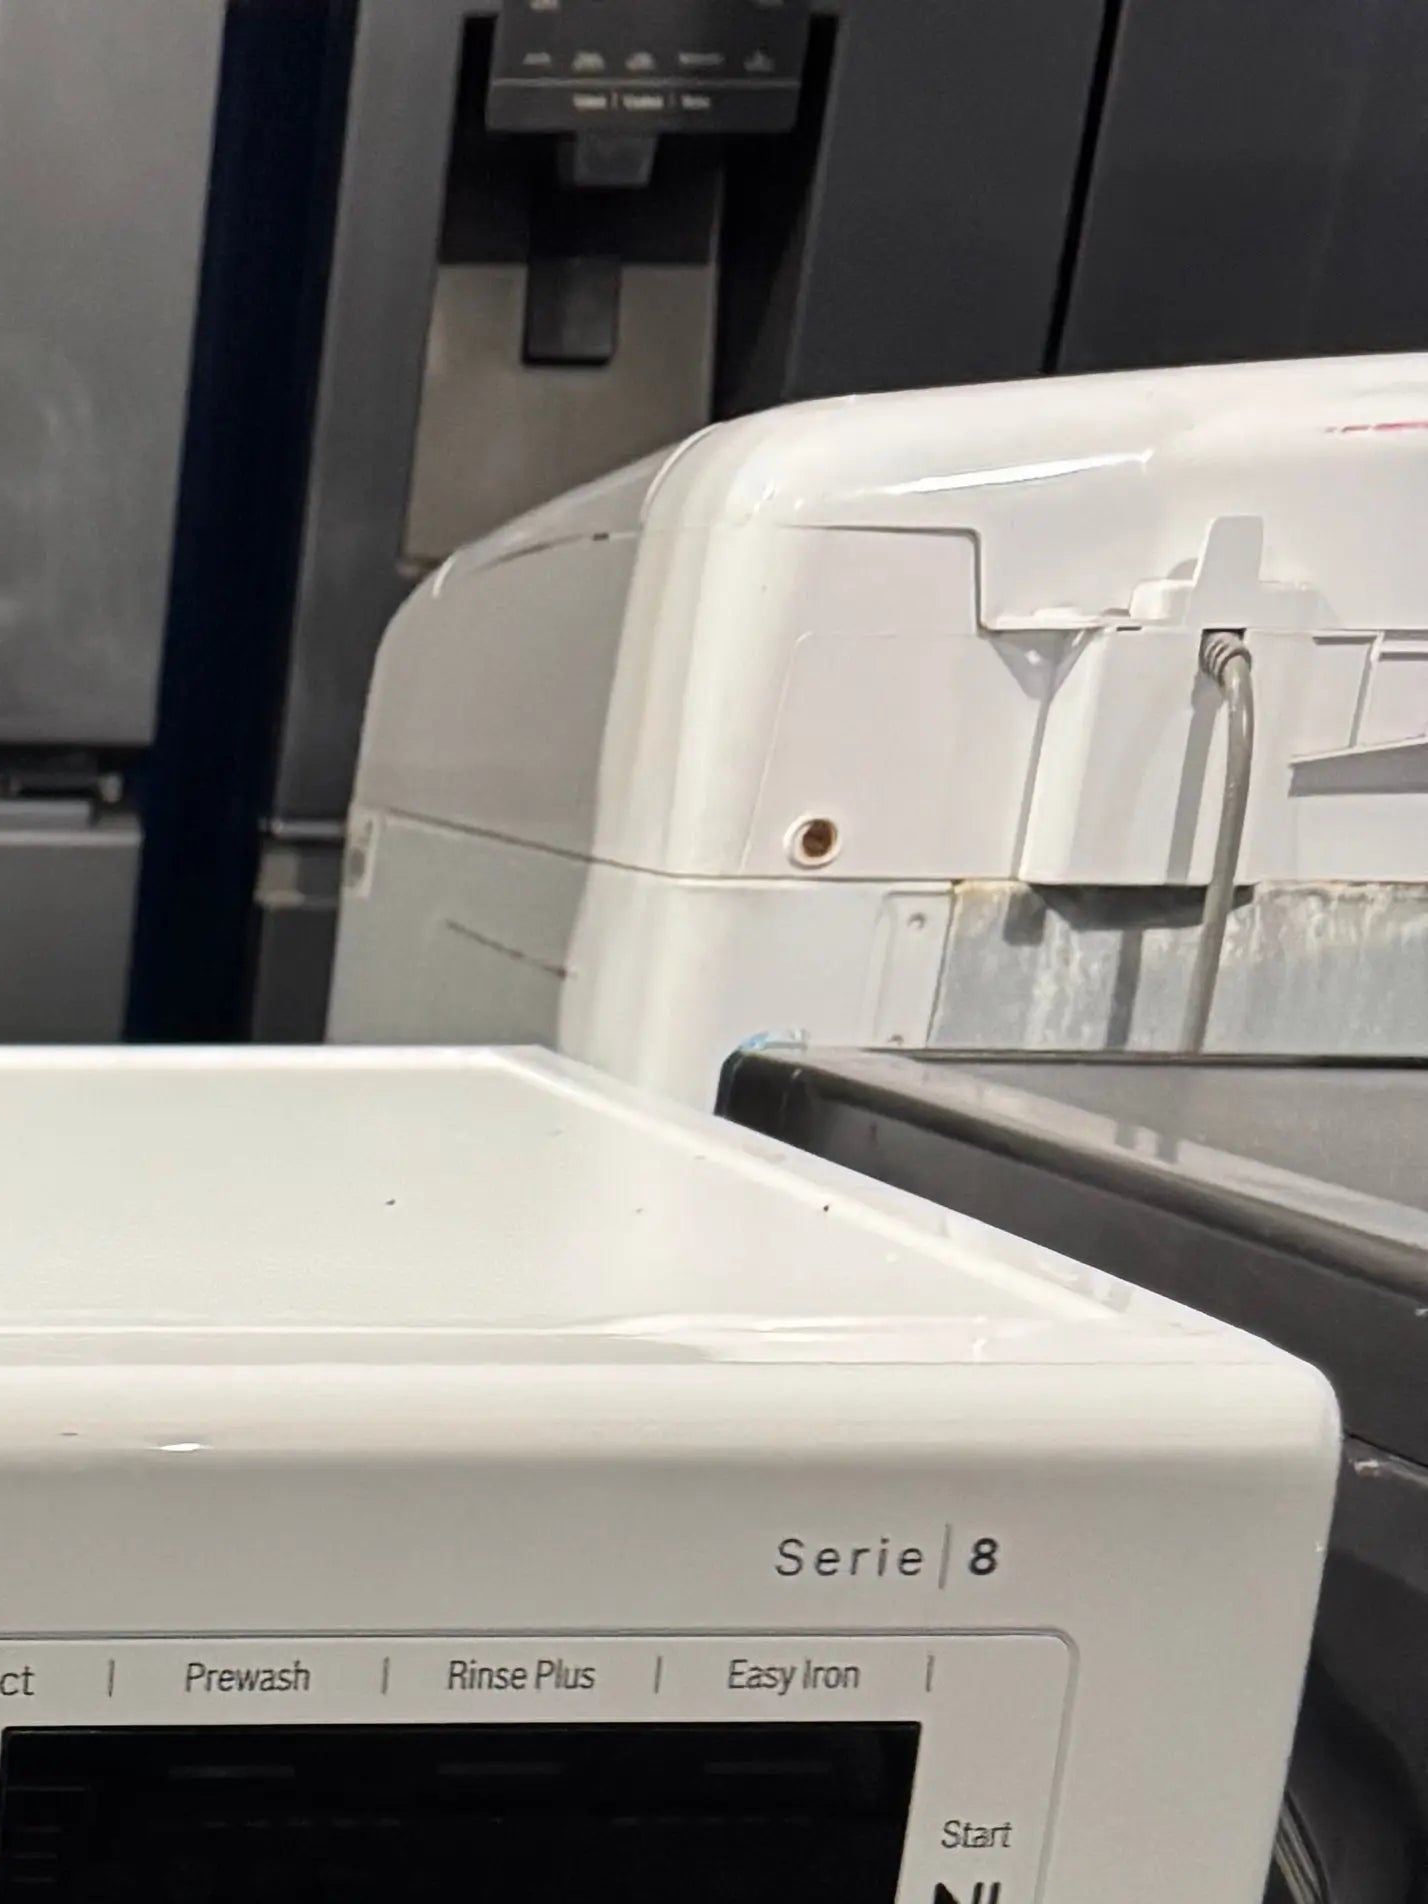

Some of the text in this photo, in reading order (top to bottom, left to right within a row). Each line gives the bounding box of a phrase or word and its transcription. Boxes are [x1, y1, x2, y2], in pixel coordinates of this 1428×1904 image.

[775, 1537, 999, 1577] Serie 8
[185, 1660, 311, 1692] Prewash
[448, 1659, 596, 1691] Rinse Plus
[727, 1659, 860, 1695] Easy Iron
[941, 1820, 1013, 1849] Start
